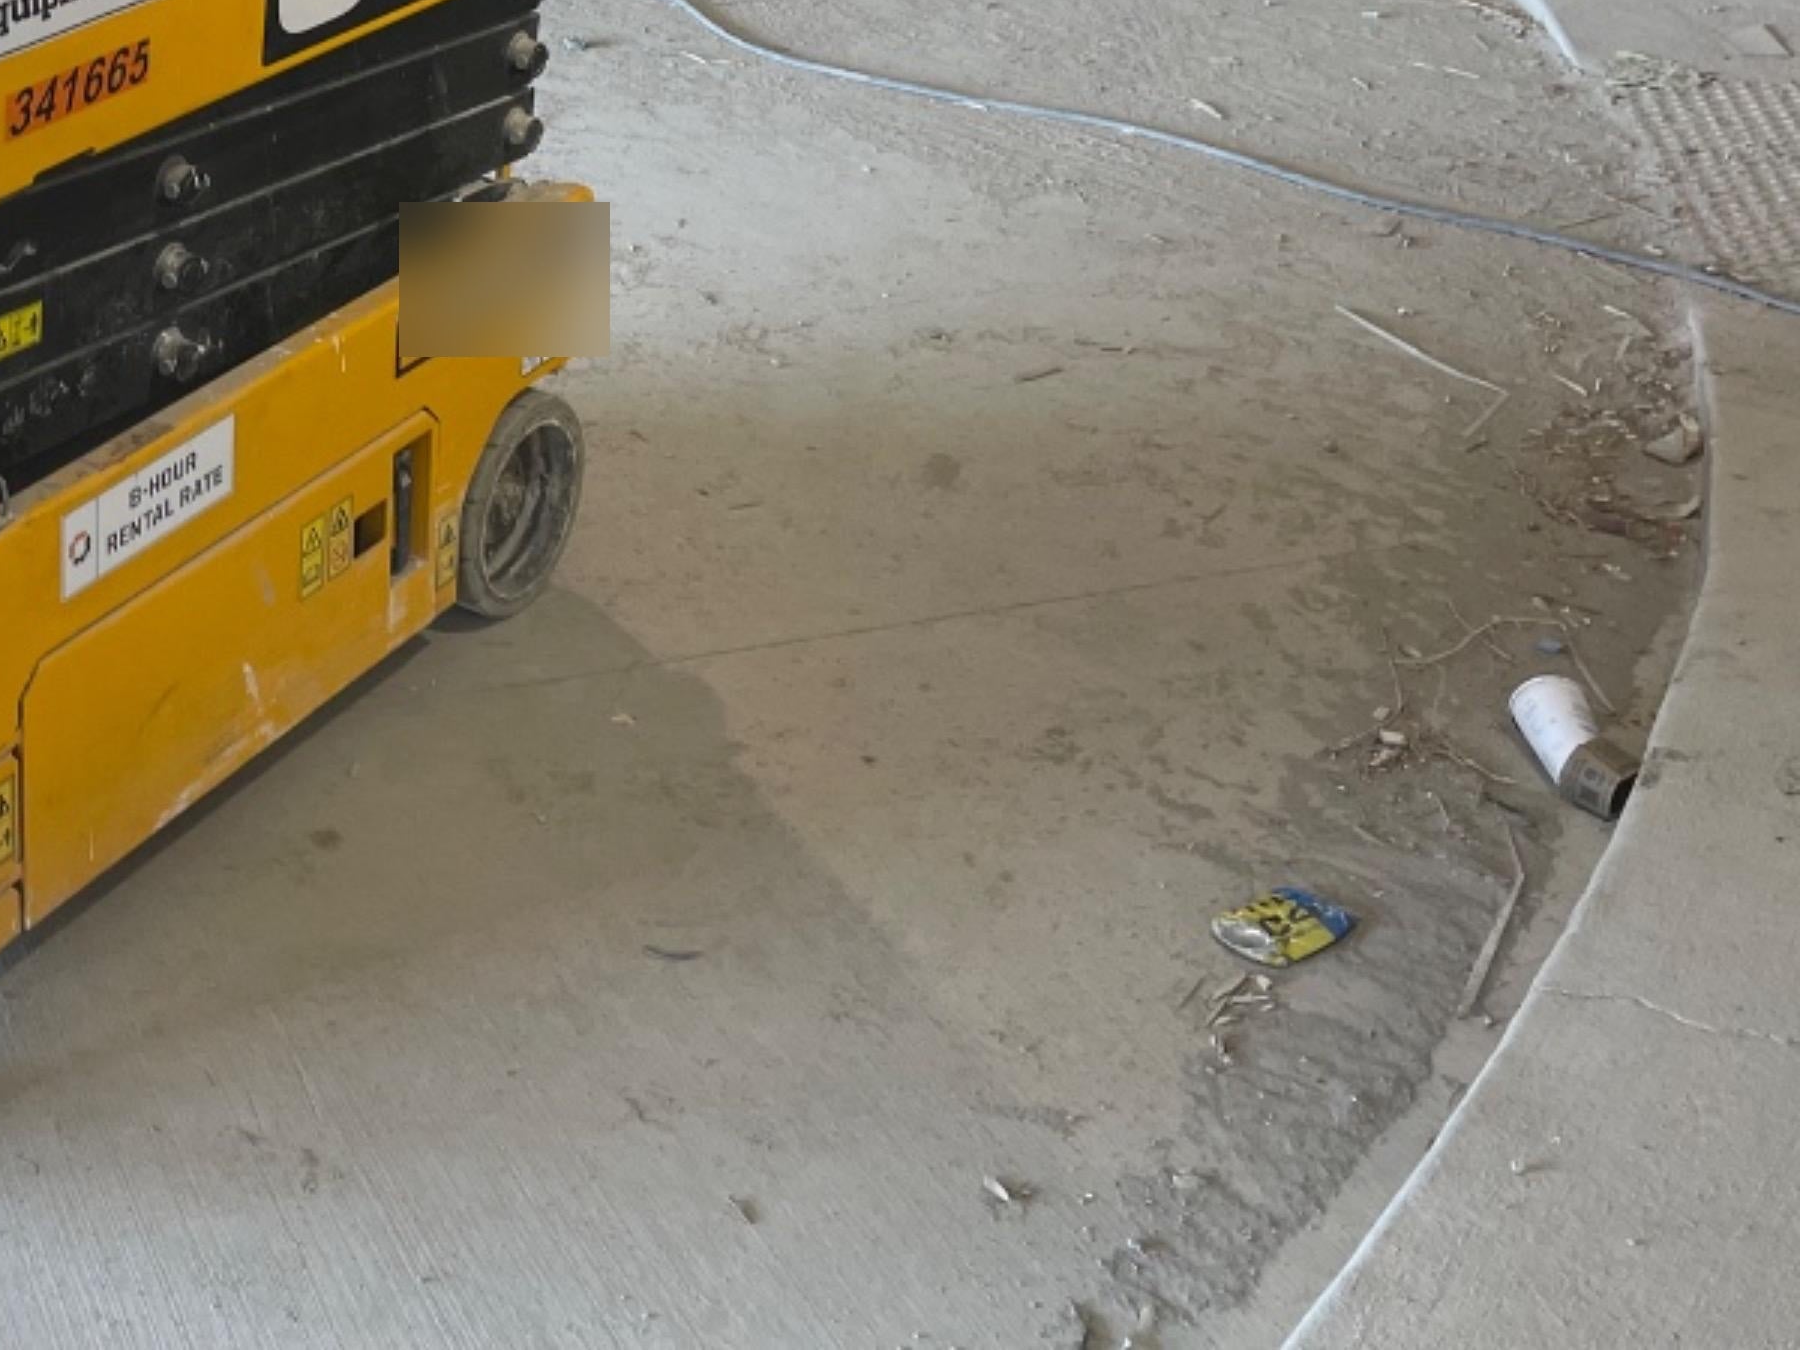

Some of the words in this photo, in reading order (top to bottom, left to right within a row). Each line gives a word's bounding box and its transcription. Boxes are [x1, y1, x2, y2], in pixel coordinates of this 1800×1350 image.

[11, 38, 150, 137] 341665
[107, 498, 175, 555] RENTAL
[179, 464, 224, 508] RATE
